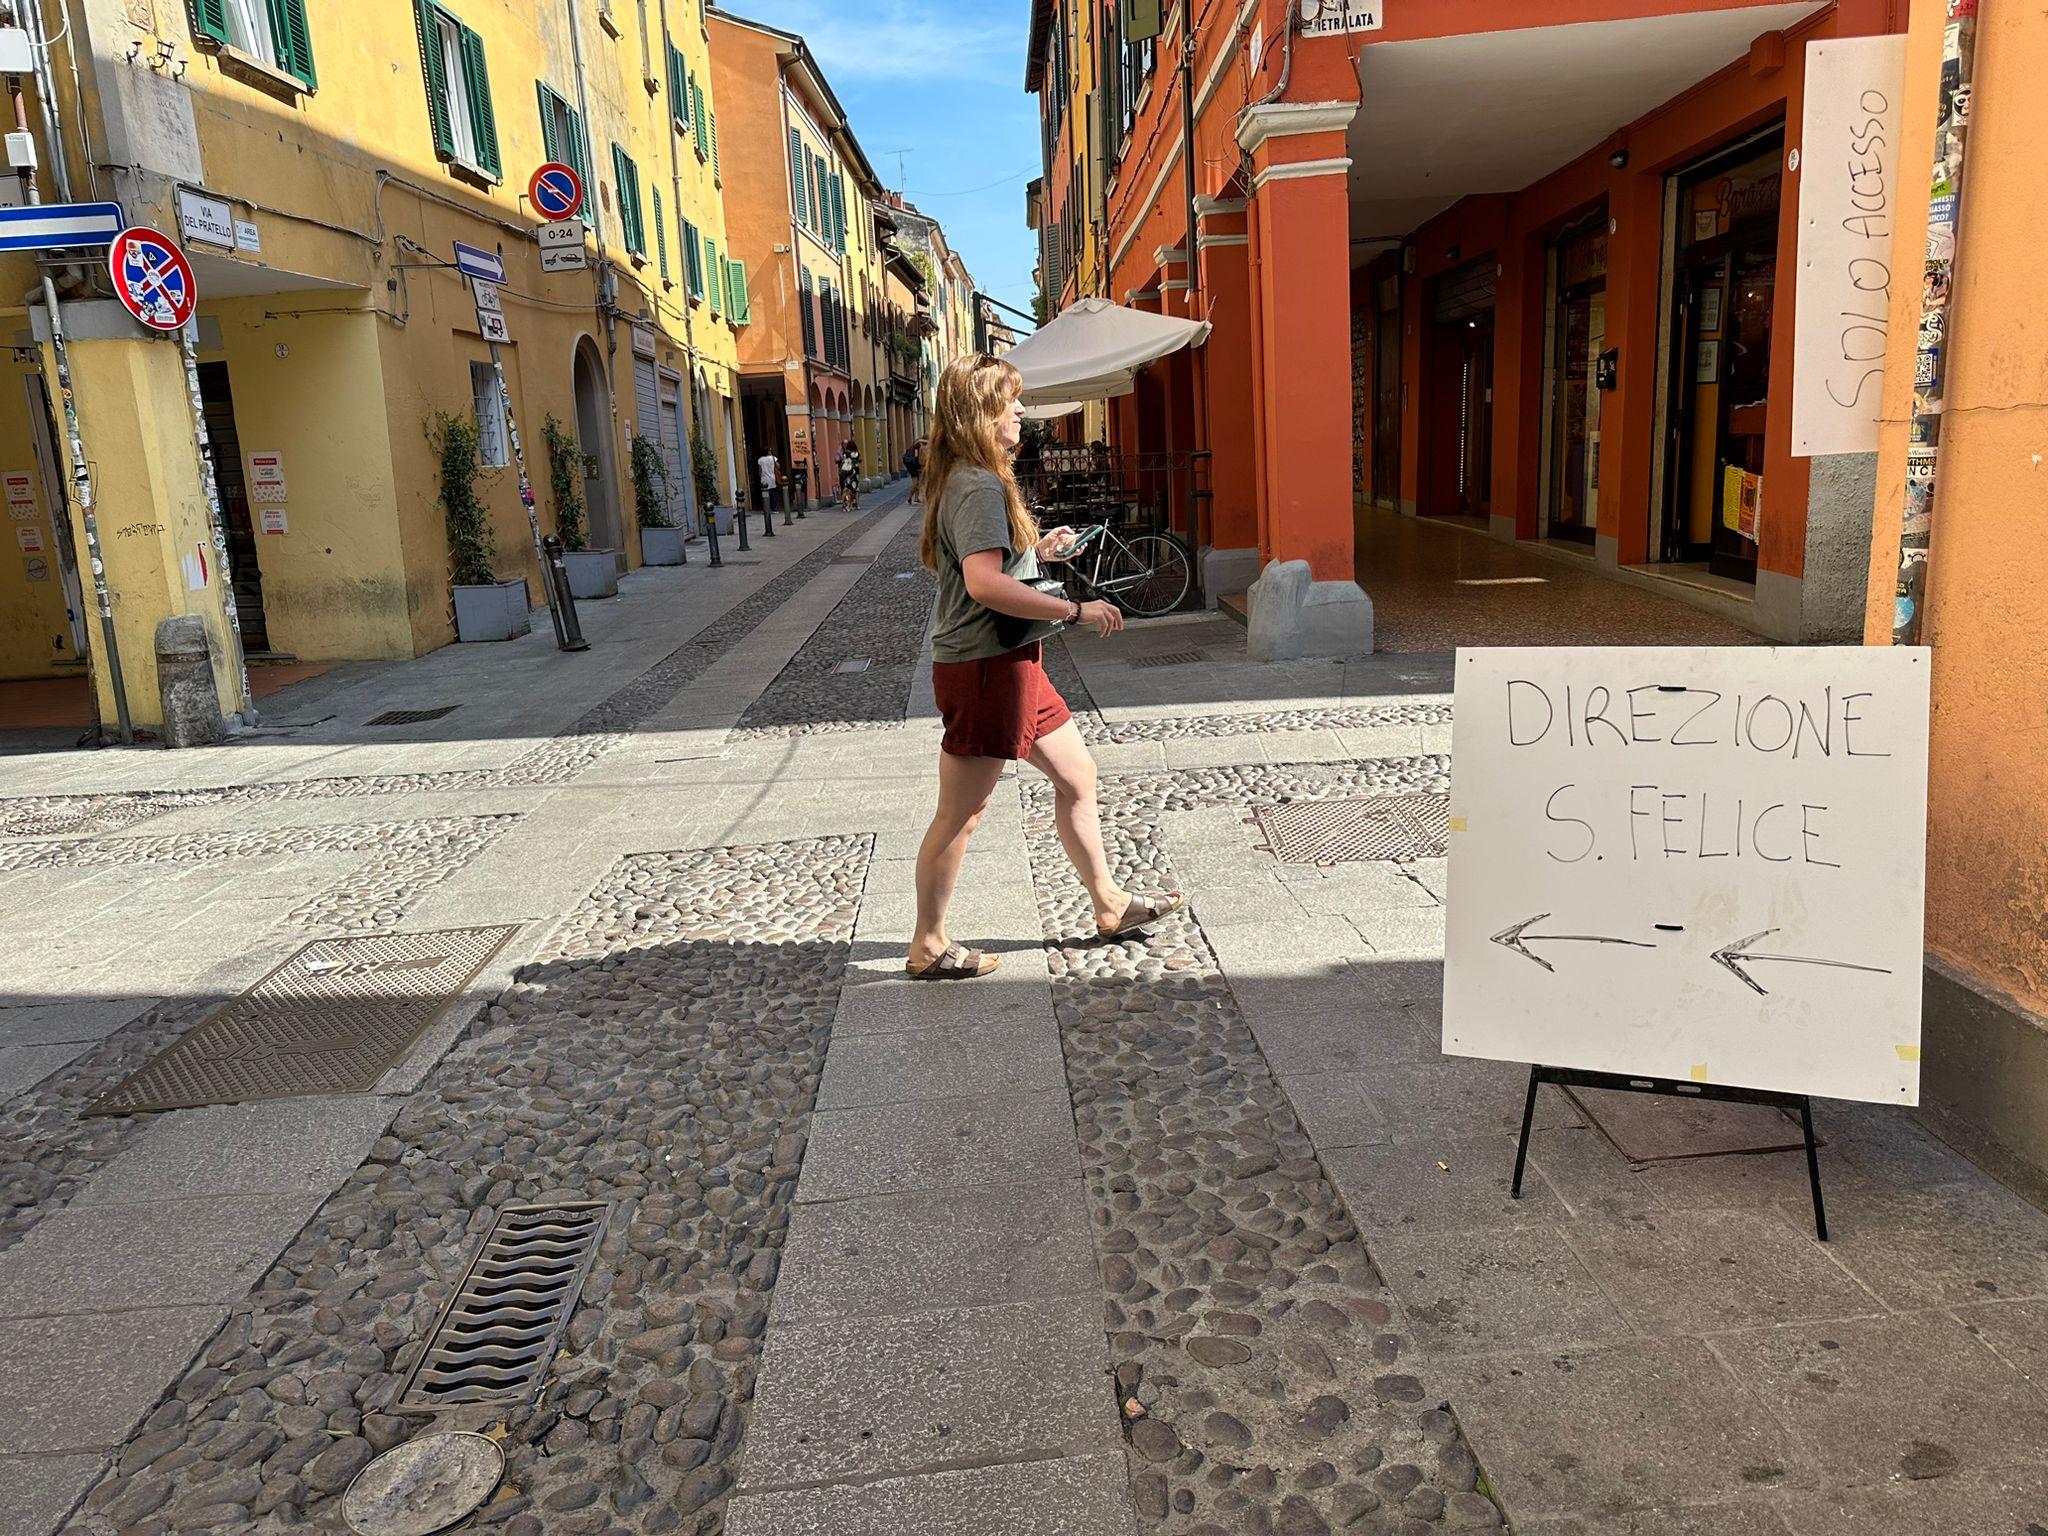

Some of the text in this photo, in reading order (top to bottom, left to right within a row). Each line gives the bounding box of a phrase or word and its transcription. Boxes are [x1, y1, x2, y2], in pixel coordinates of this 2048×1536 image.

[1314, 13, 1374, 32] IETRALATA
[1842, 89, 1889, 238] ACCESSO
[200, 205, 213, 219] VIA
[183, 214, 231, 238] DEL PRATELLO
[548, 228, 573, 240] 0-24
[1507, 679, 1892, 759] DIREZIONE
[1546, 783, 1841, 868] S. FELICE
